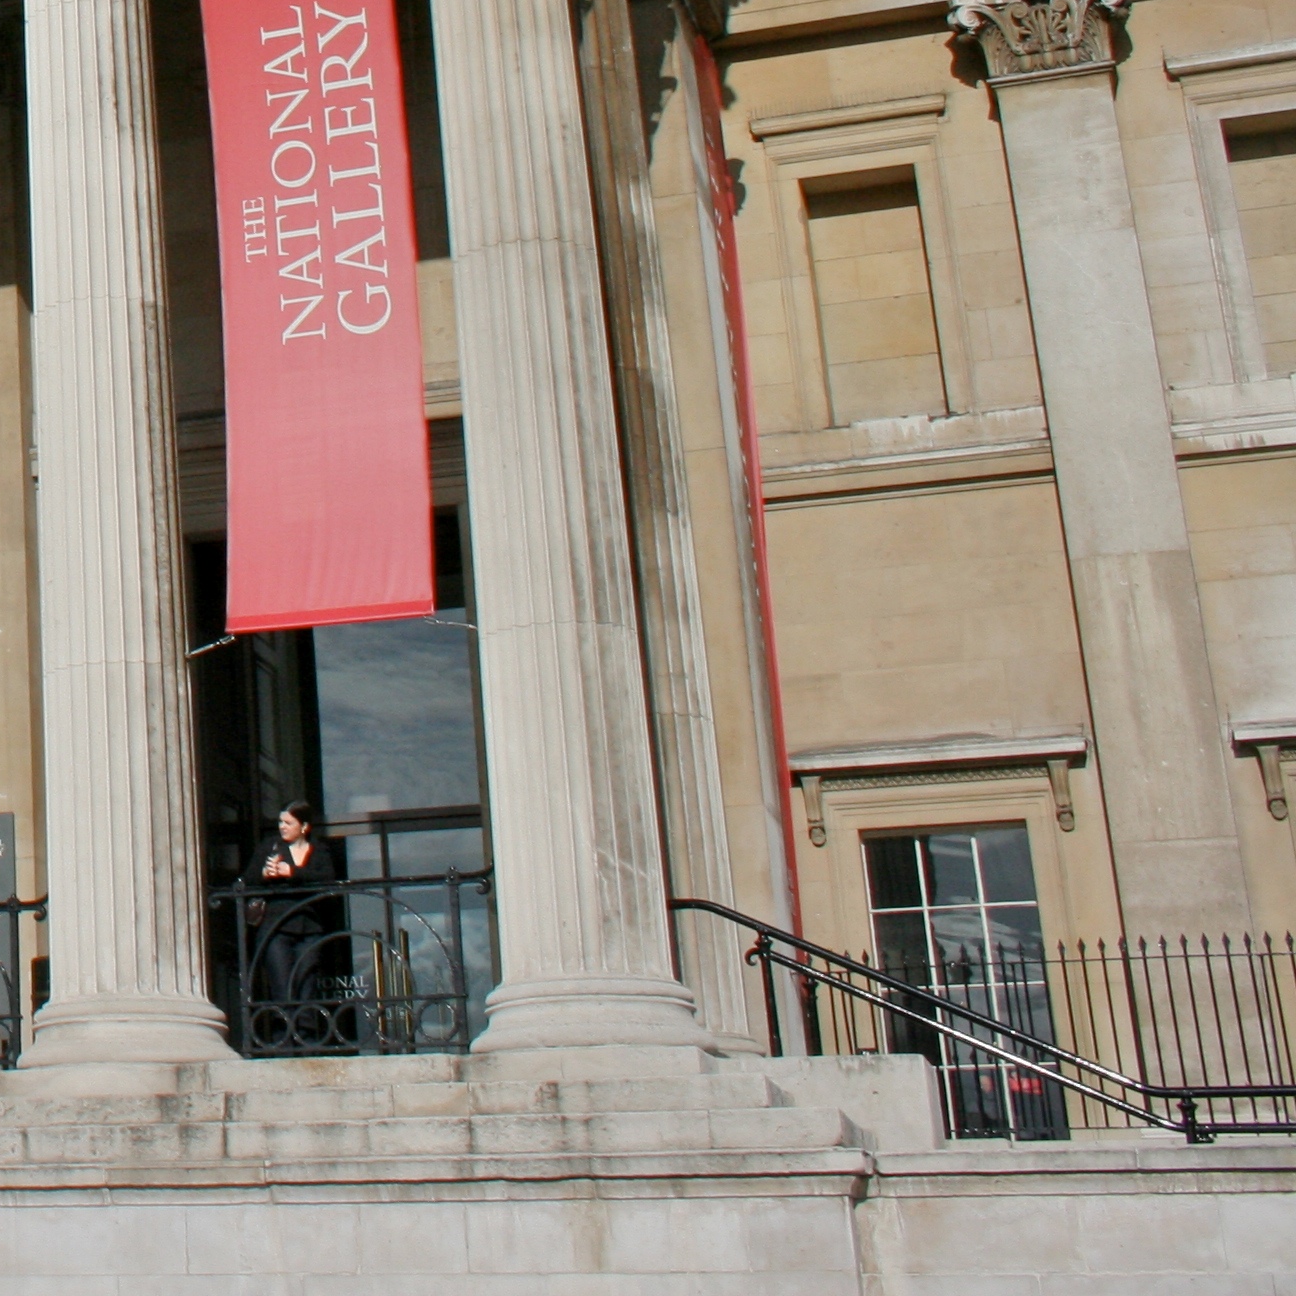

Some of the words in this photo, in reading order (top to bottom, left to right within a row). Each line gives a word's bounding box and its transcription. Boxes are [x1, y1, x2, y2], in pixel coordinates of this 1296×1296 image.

[242, 195, 267, 263] THE
[260, 4, 326, 345] NATIONAL
[313, 1, 392, 335] GALLERY
